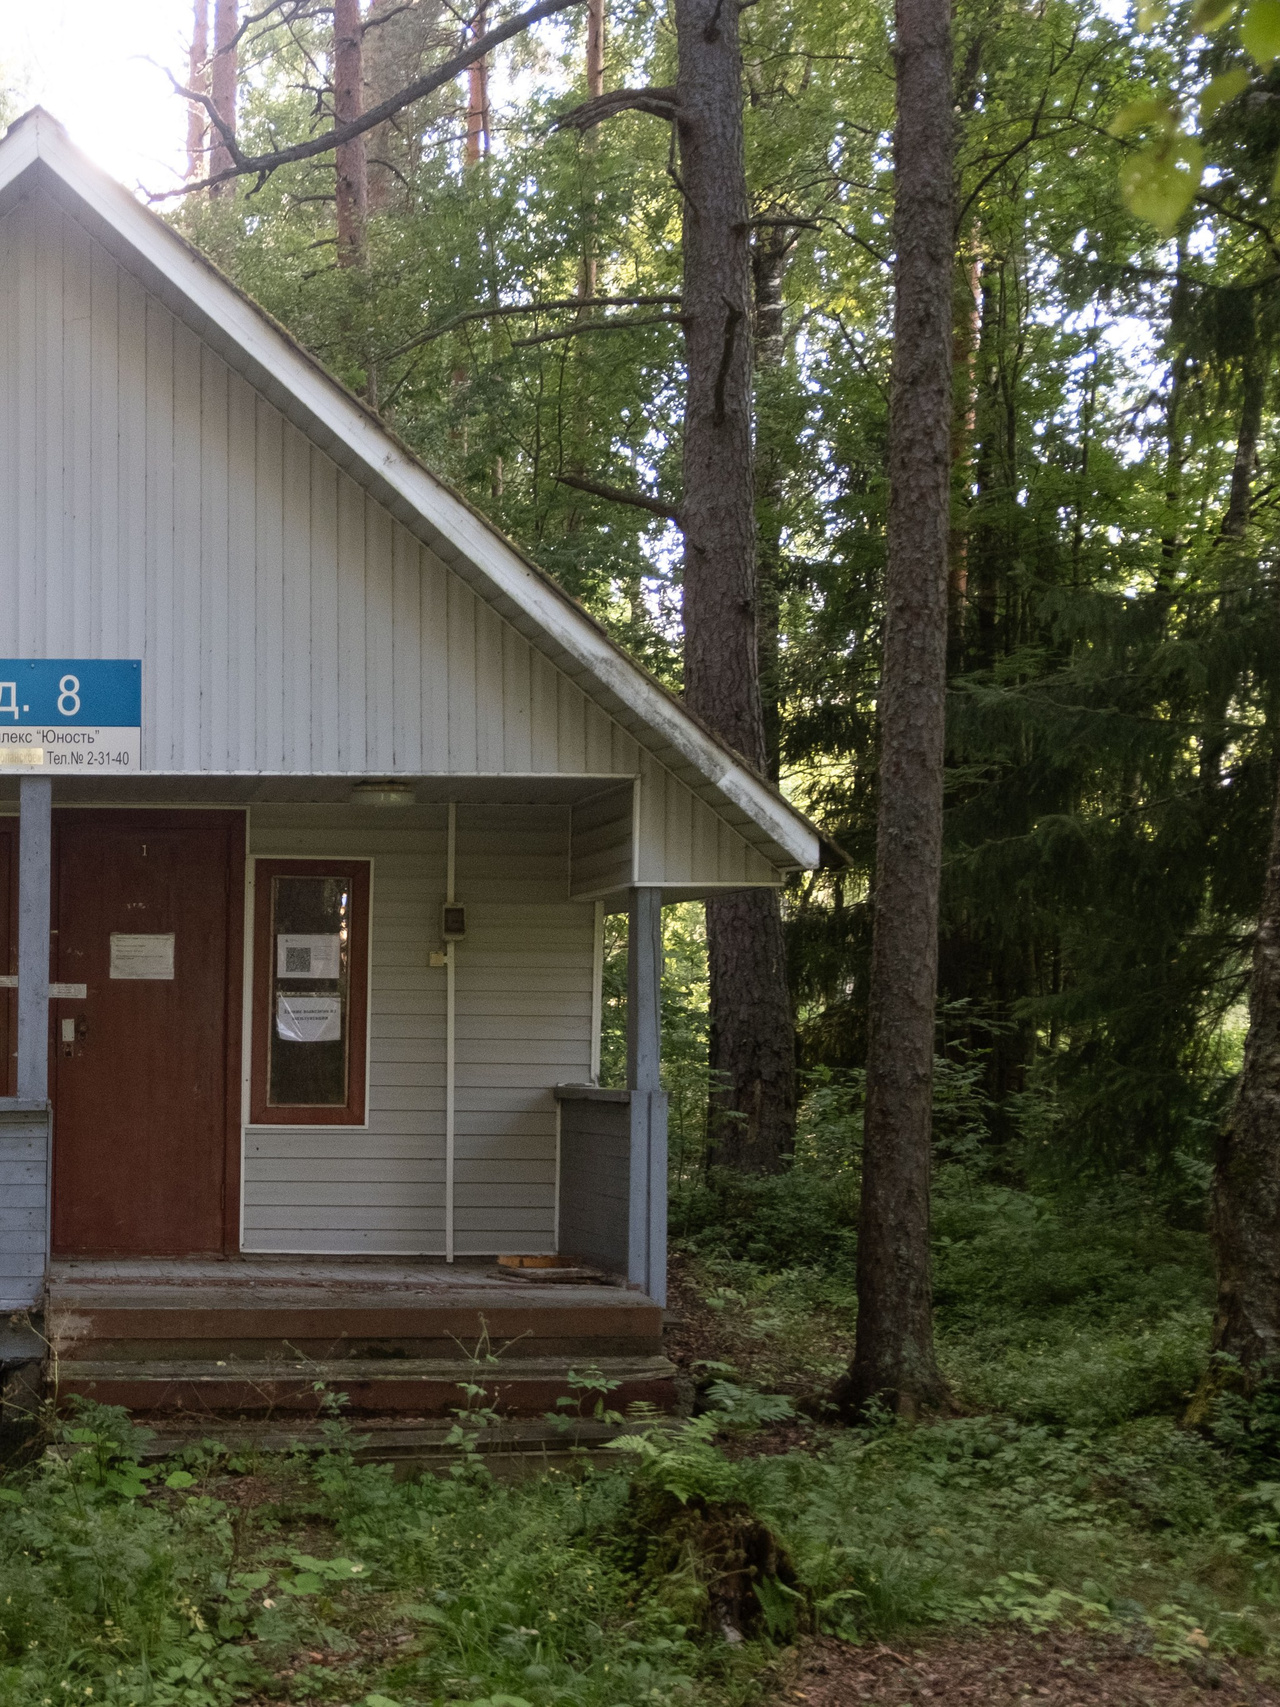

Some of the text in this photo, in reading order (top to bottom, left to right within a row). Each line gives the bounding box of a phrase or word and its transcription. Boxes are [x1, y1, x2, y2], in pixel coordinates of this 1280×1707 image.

[57, 674, 81, 717] 8
[87, 751, 130, 765] 2-31-40
[141, 844, 148, 857] 1
